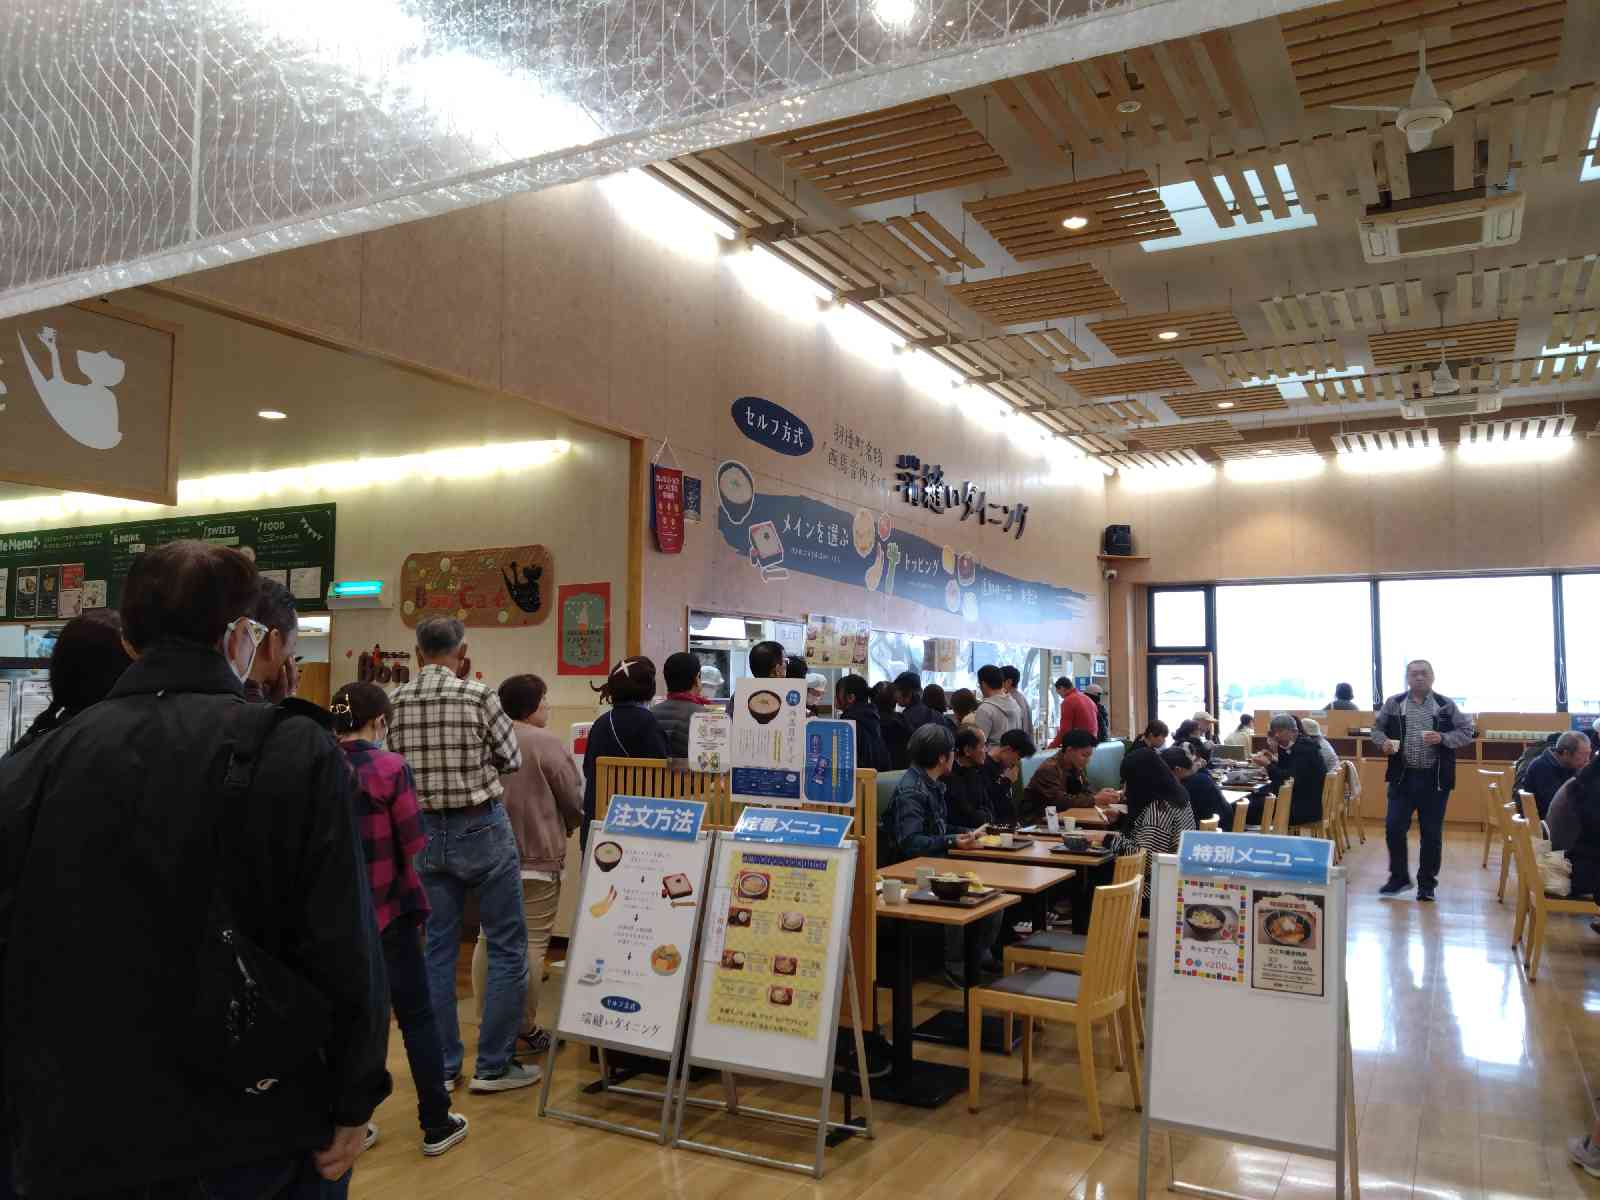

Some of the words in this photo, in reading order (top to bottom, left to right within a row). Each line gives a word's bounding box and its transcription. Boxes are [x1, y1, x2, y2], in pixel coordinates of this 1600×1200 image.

[744, 406, 804, 448] セルフ方式
[207, 525, 237, 537] SWEETS
[263, 520, 286, 531] FOOD
[783, 513, 849, 548] メインを選ぶ
[905, 552, 941, 574] トッピング
[612, 803, 696, 834] 注文方法
[741, 815, 840, 835] 定番メニュー
[1191, 845, 1315, 867] 特別メニュー
